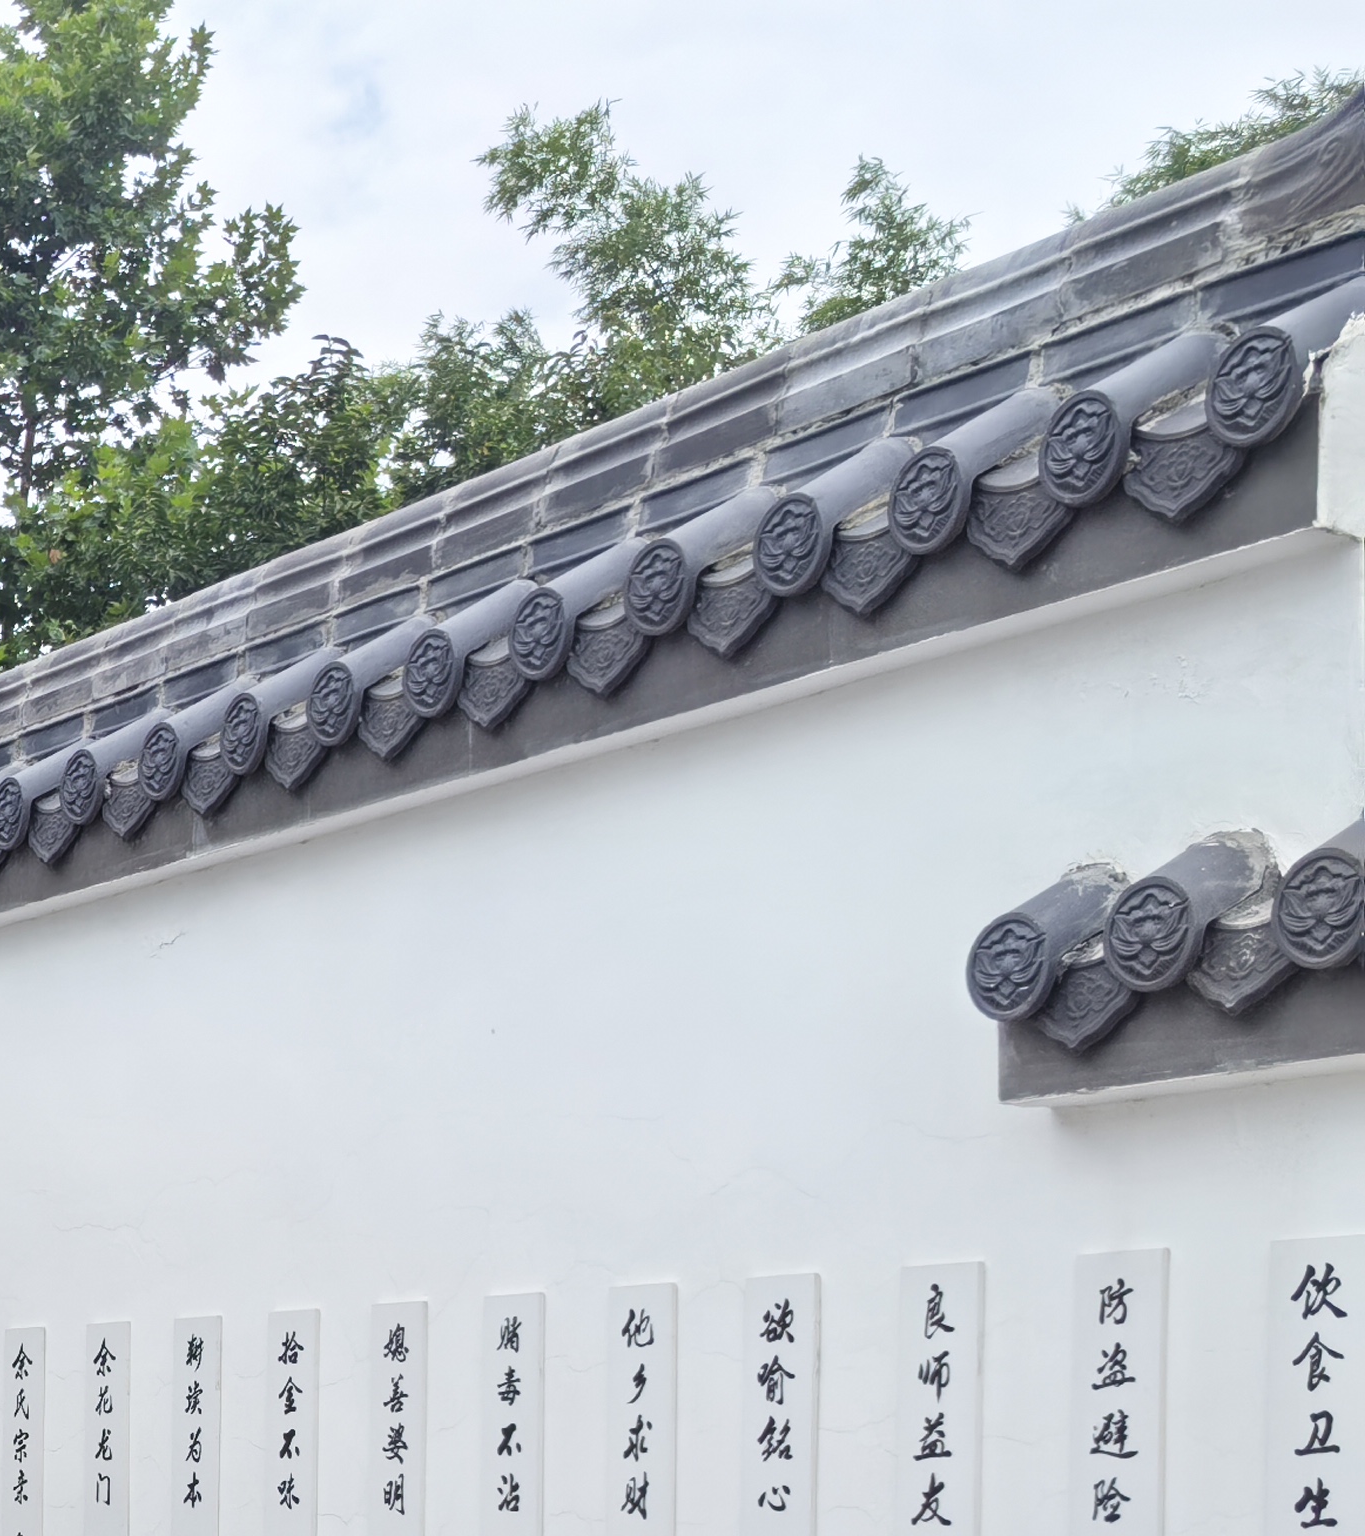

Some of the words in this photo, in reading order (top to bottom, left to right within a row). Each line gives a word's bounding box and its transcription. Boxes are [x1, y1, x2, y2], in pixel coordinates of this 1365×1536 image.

[10, 1343, 34, 1505] 余氏宗亲
[182, 1334, 205, 1508] 耕读为本
[276, 1331, 306, 1510] 拾金不昧
[496, 1316, 523, 1512] 赌毒不沾
[620, 1309, 656, 1520] 他乡求财
[756, 1298, 797, 1512] 欲喻铭心
[910, 1283, 956, 1526] 良师益友
[1089, 1278, 1140, 1523] 防盗避险
[1289, 1262, 1349, 1529] 饮食卫生
